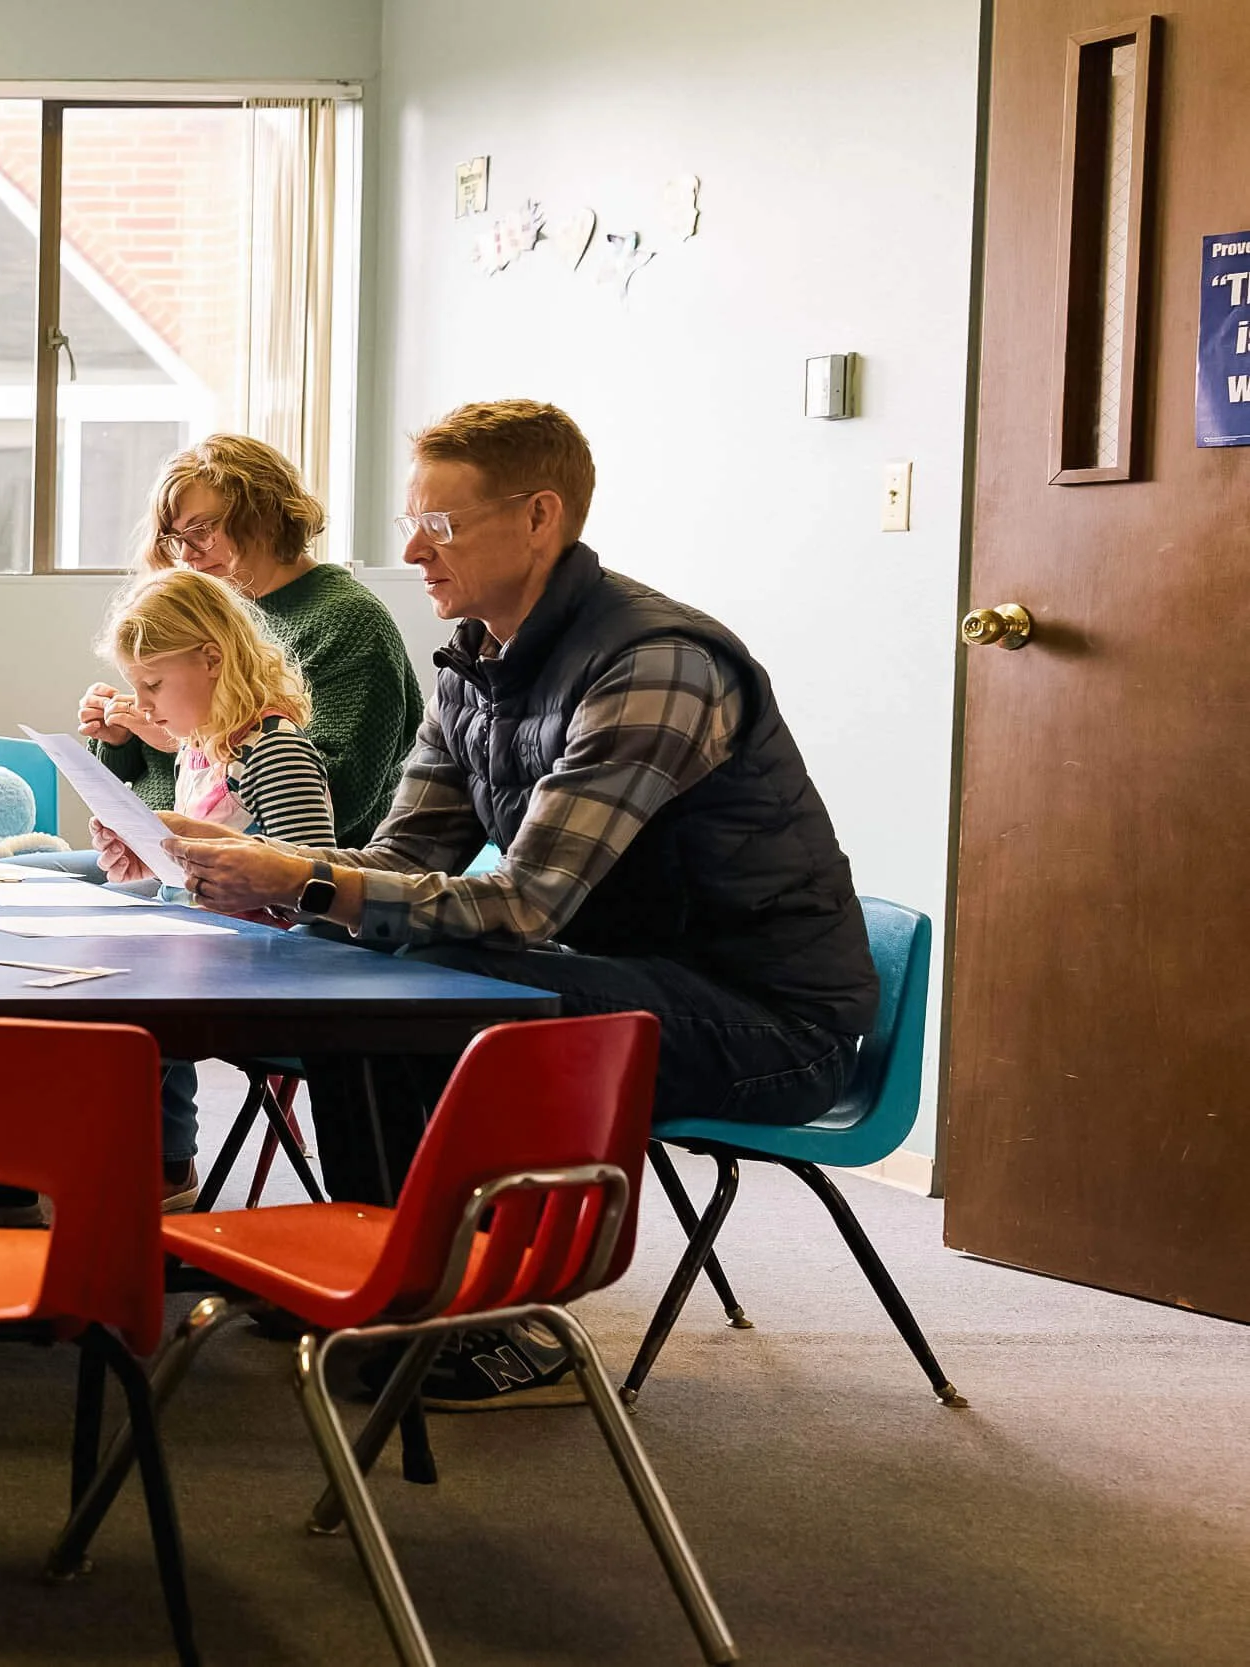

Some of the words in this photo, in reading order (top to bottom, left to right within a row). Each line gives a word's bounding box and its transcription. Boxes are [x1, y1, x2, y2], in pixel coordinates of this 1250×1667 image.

[1212, 272, 1250, 306] “T
[1236, 320, 1250, 354] i
[471, 1345, 535, 1392] N
